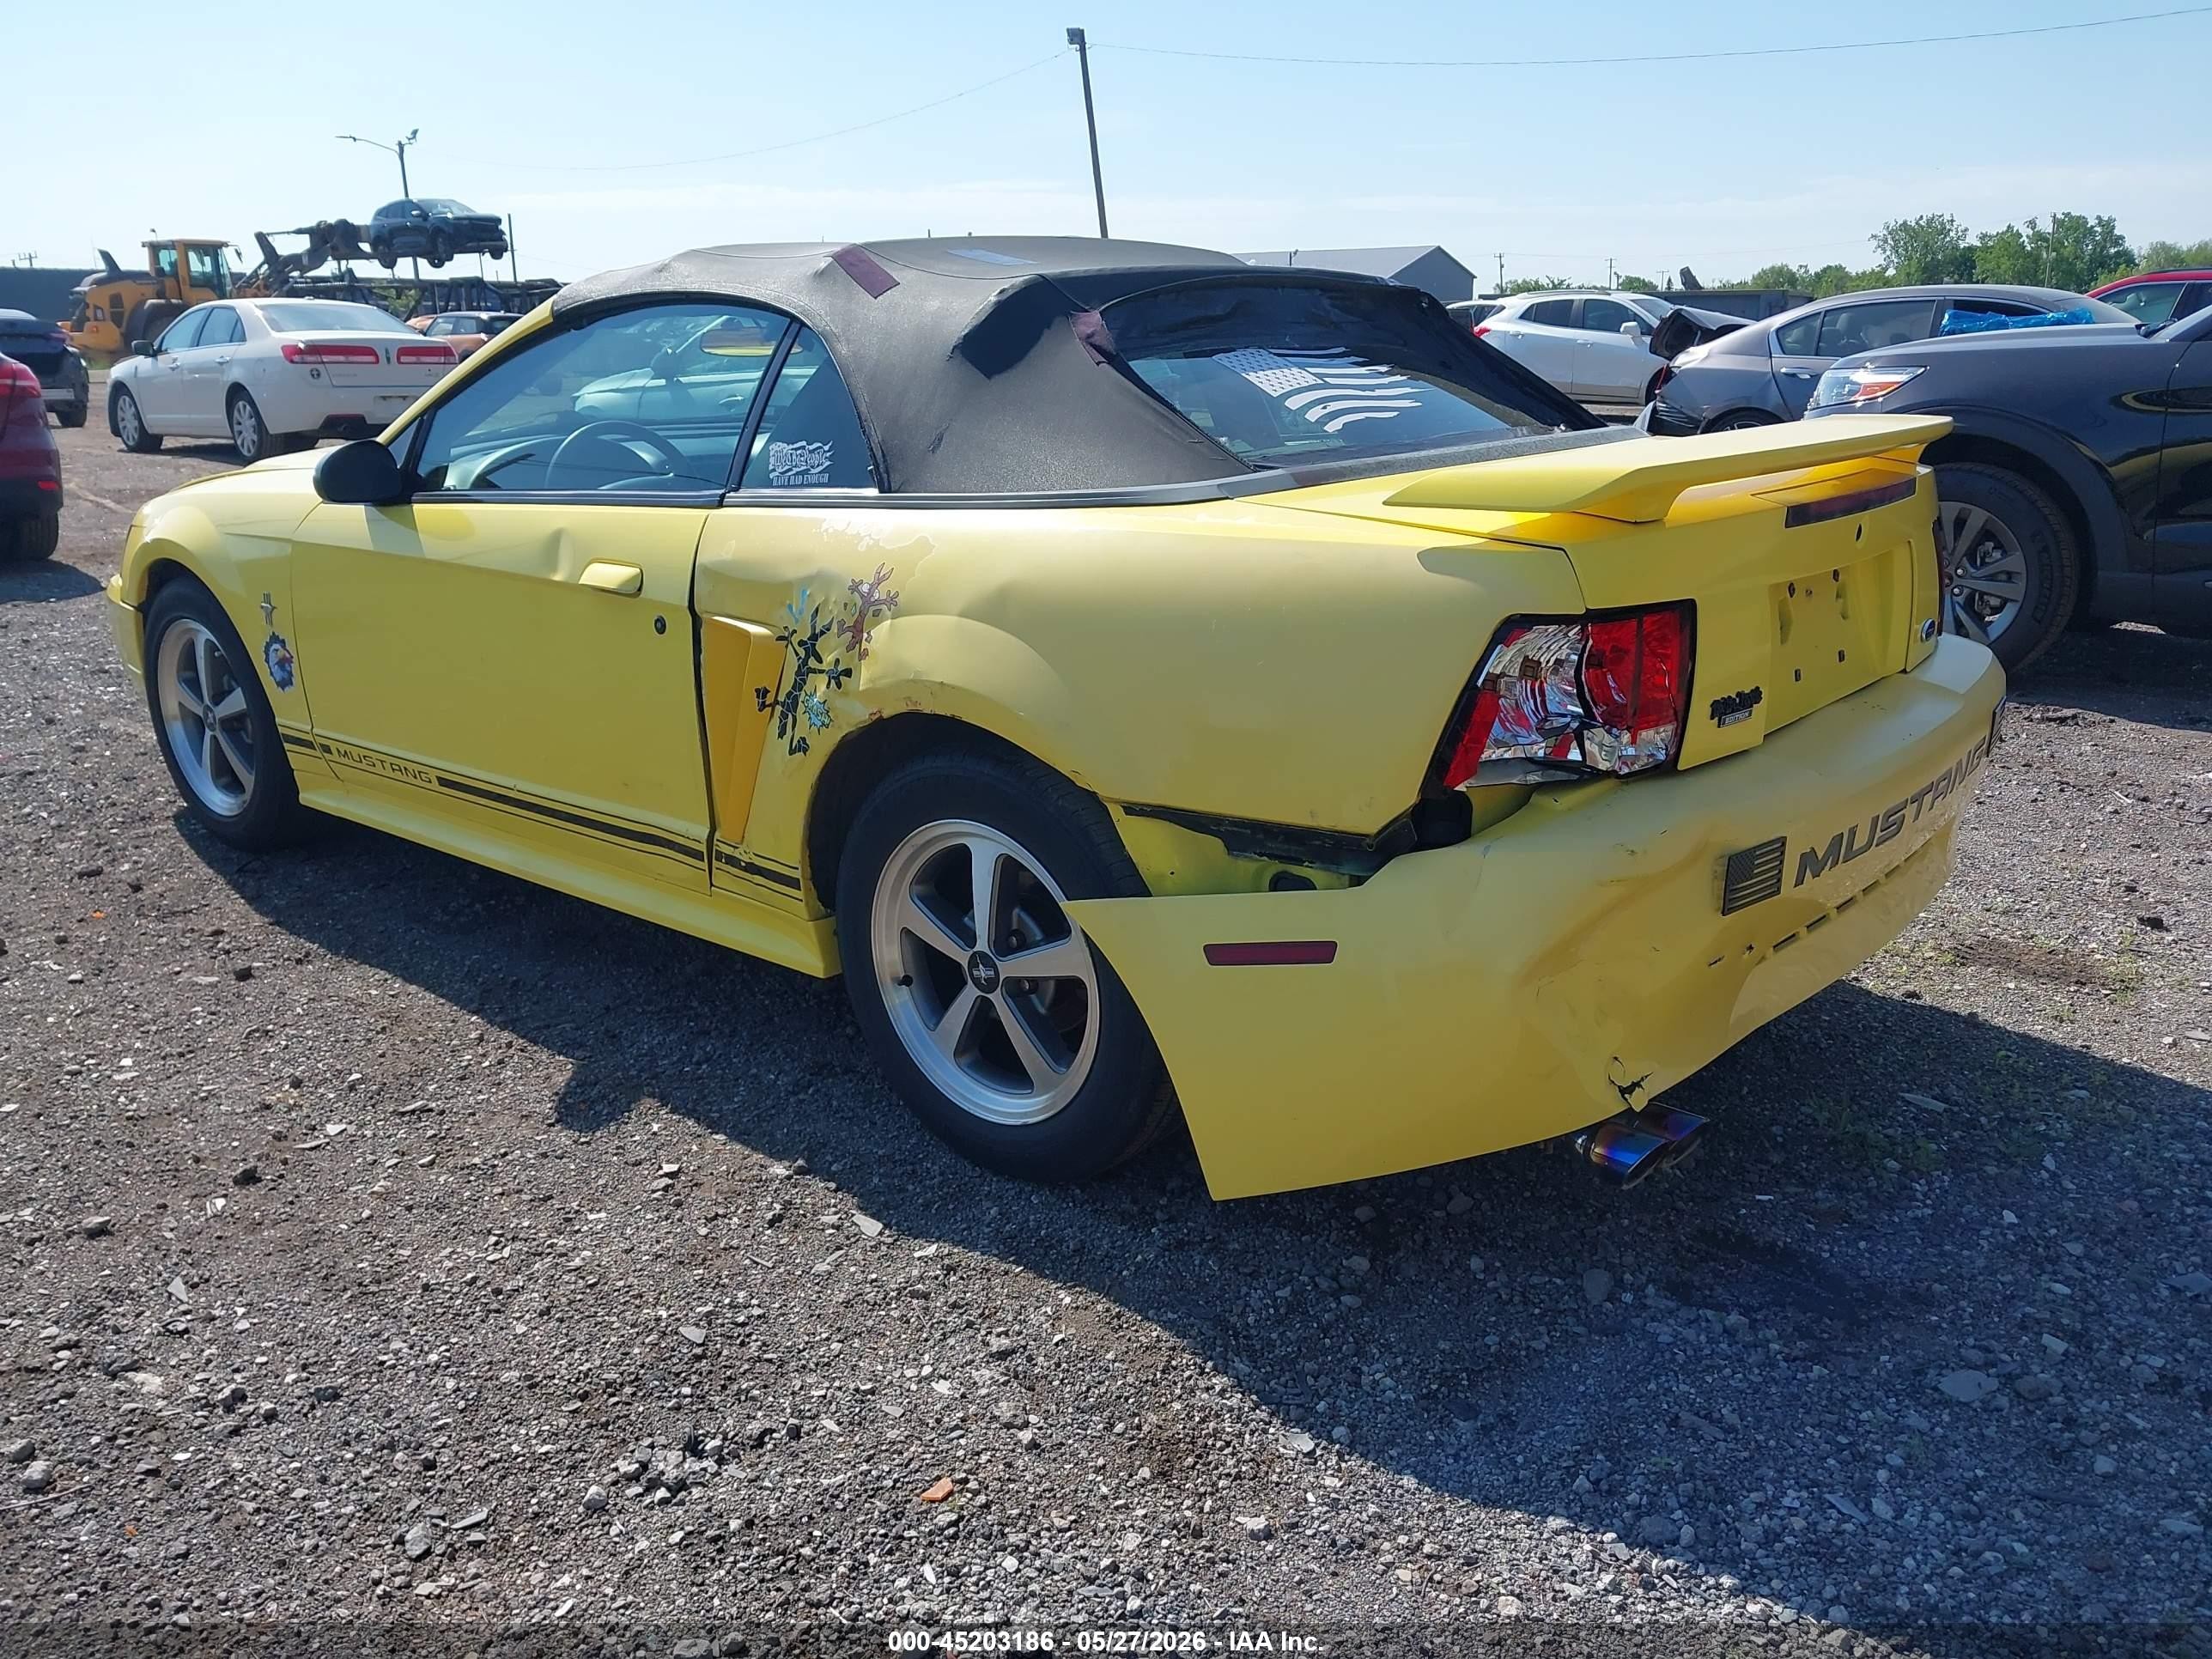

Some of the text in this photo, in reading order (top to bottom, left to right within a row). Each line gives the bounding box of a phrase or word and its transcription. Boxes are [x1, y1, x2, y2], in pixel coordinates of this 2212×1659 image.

[773, 473, 830, 486] HAVE HAD ENOUGH
[1724, 711, 1750, 725] EDITION
[335, 746, 433, 784] MUSTANG
[1793, 734, 1987, 889] MUSTANG
